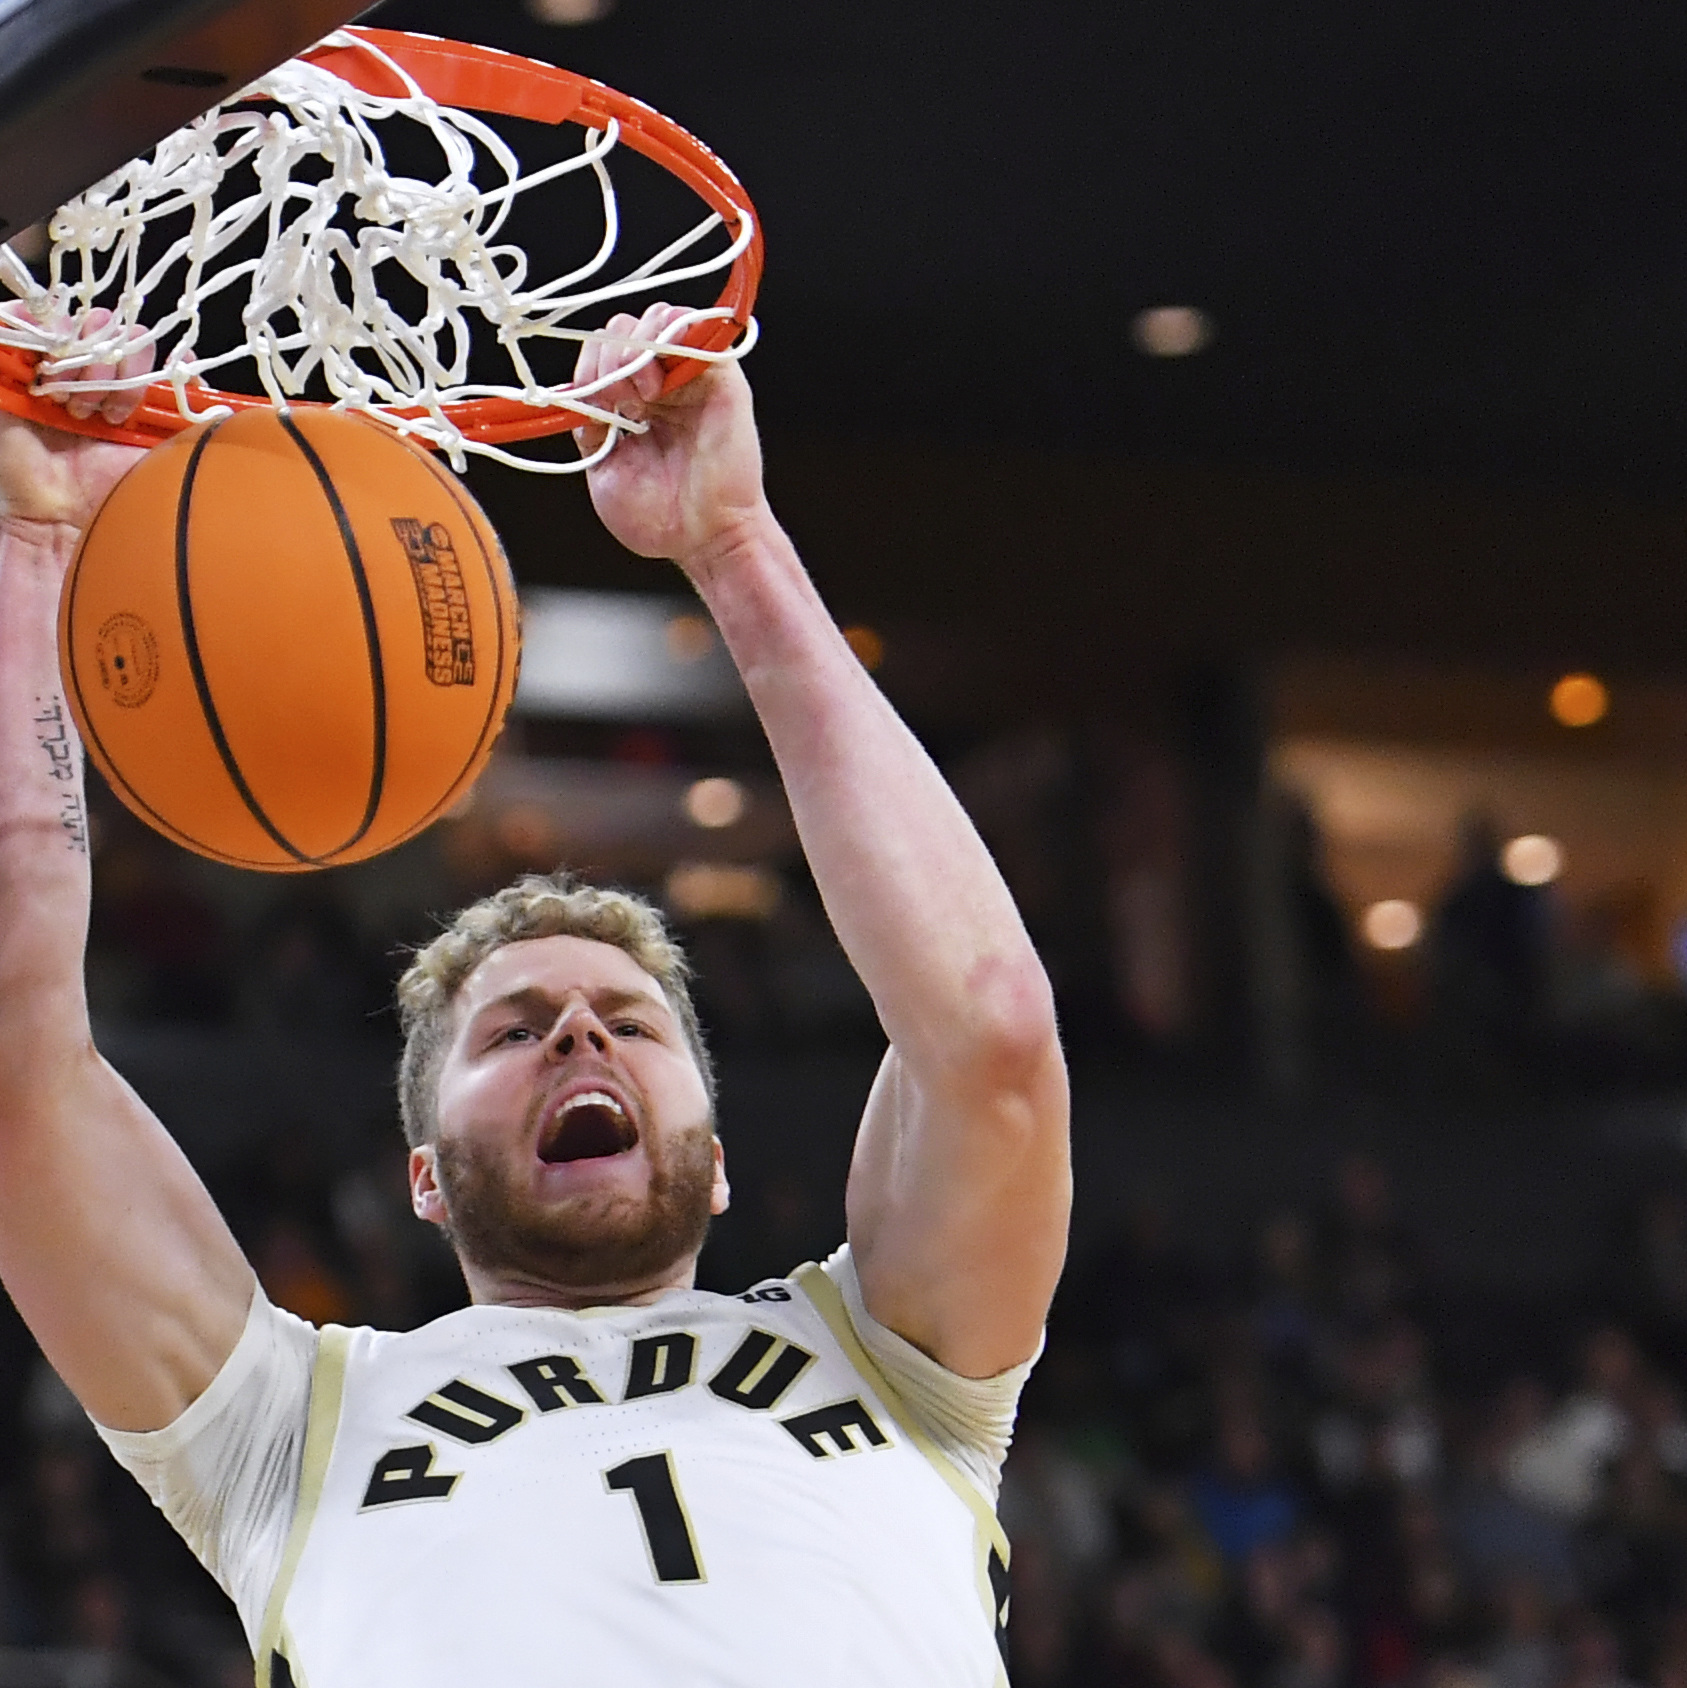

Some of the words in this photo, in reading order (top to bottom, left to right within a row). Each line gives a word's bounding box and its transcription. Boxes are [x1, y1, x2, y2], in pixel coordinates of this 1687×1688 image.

[419, 562, 455, 685] MADNESS
[357, 1324, 894, 1514] PURDUE
[601, 1448, 708, 1586] 1
